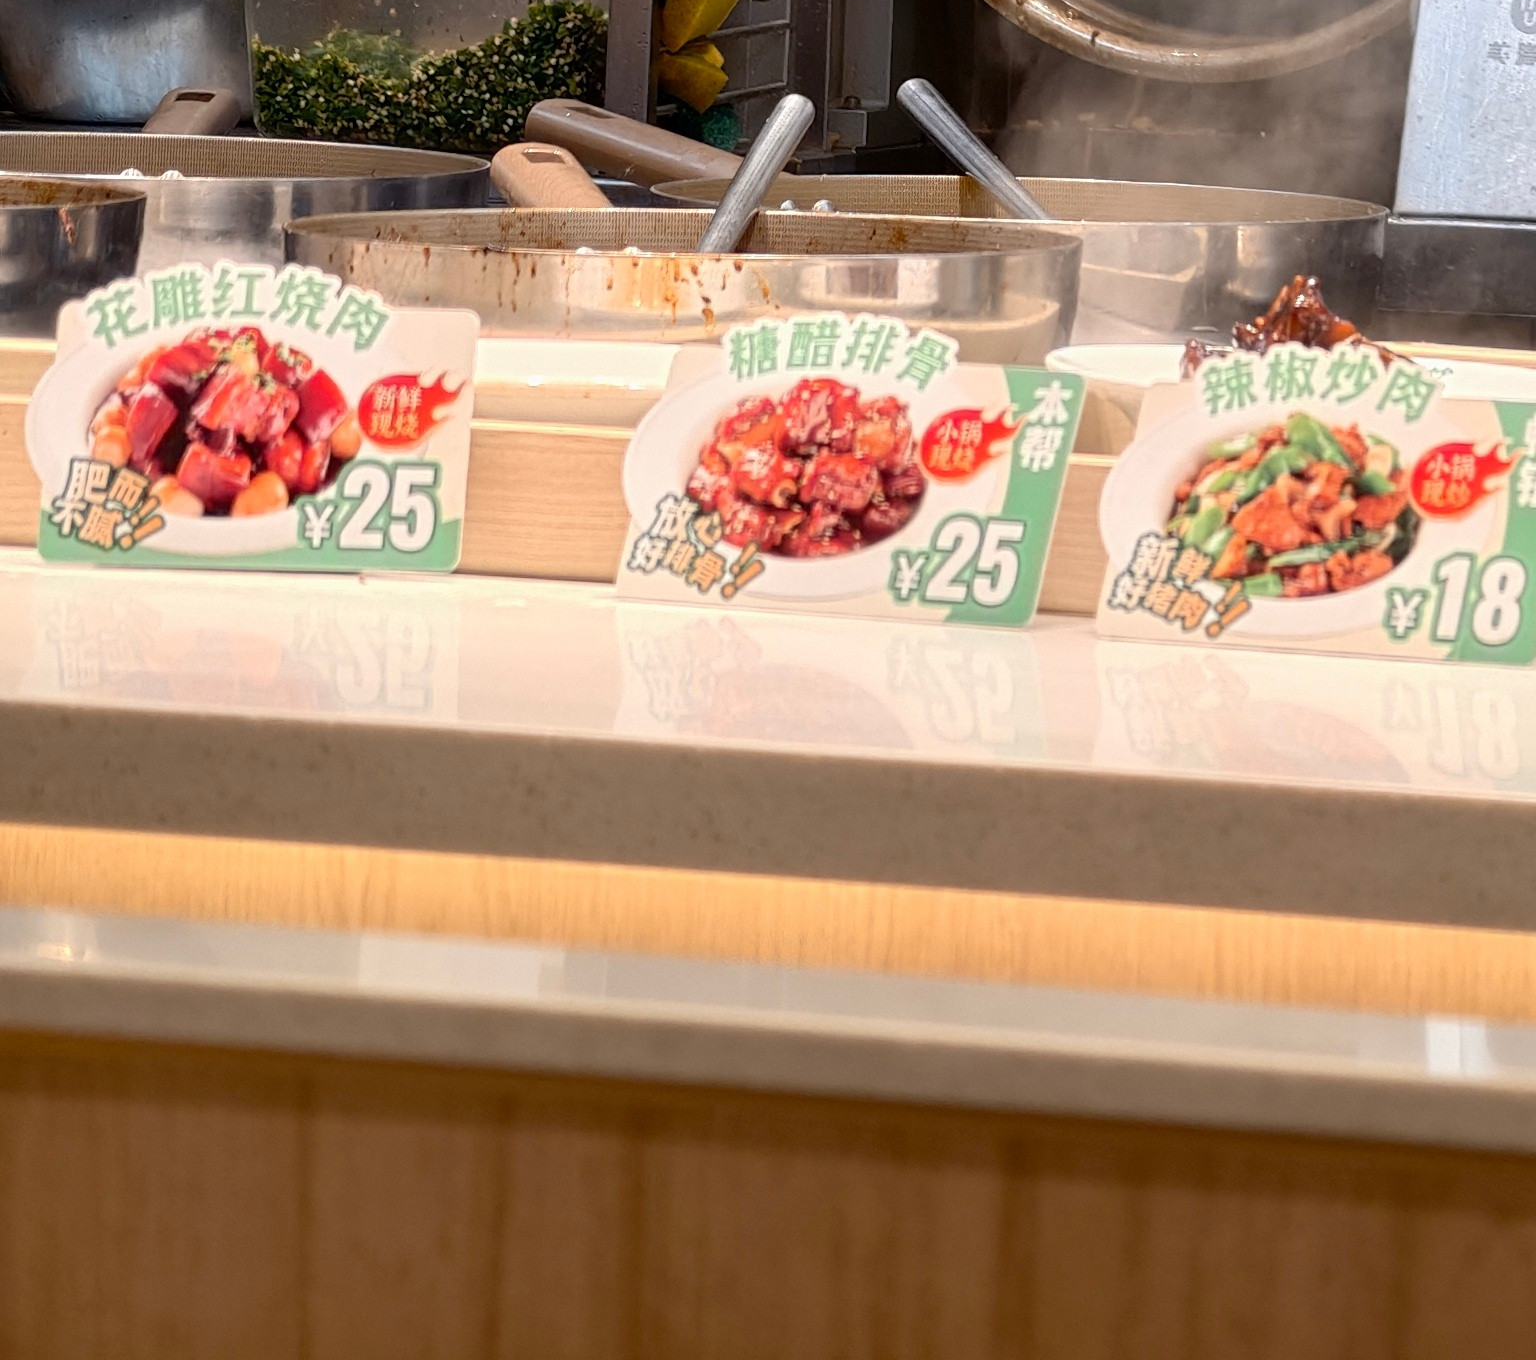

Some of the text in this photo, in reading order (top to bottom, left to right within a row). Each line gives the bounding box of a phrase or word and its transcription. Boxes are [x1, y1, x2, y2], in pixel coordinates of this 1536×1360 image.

[86, 269, 391, 352] 花雕红烧肉
[729, 320, 953, 391] 糖醋排骨
[1202, 346, 1437, 422] 辣椒炒肉
[1018, 381, 1074, 472] 本帮
[65, 460, 148, 509] 肥而
[304, 465, 438, 551] ¥25
[650, 495, 722, 548] 放心
[893, 517, 1025, 606] ¥25
[1133, 536, 1212, 584] 新鲜
[1386, 554, 1527, 646] ¥18
